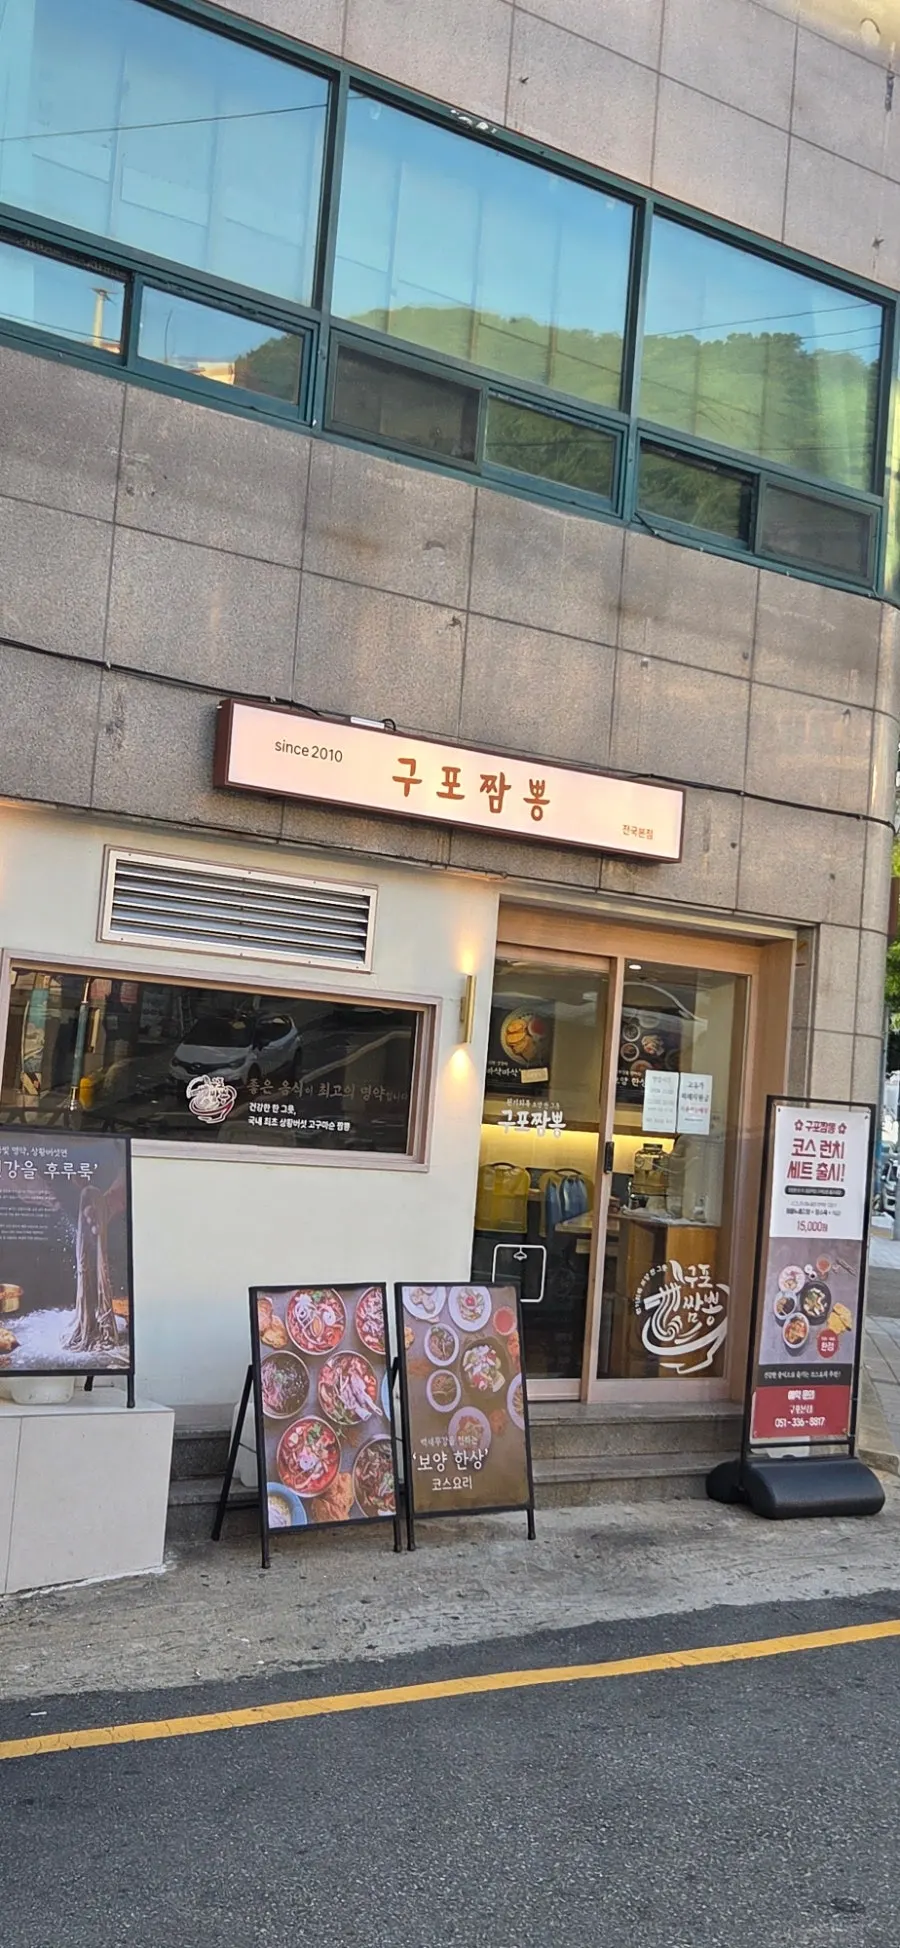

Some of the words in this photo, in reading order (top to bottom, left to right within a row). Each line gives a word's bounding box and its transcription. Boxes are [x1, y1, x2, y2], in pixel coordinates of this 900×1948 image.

[274, 738, 309, 758] since
[311, 744, 343, 764] 2010
[391, 757, 551, 822] 구포짬뽕
[247, 1078, 274, 1095] 좋은
[318, 1082, 355, 1100] 최고의
[248, 1115, 263, 1126] 국내
[264, 1117, 278, 1127] 최초
[497, 1109, 567, 1138] 구포짬뽕
[805, 1120, 837, 1134] 구포짬뽕
[791, 1138, 817, 1158] 코스
[819, 1140, 845, 1159] 런치
[0, 1160, 37, 1180] 강을
[787, 1161, 813, 1180] 세트
[816, 1162, 846, 1182] 출시!
[684, 1263, 713, 1289] 구포
[682, 1290, 723, 1326] 짬뽕
[431, 1475, 473, 1491] 코스요리
